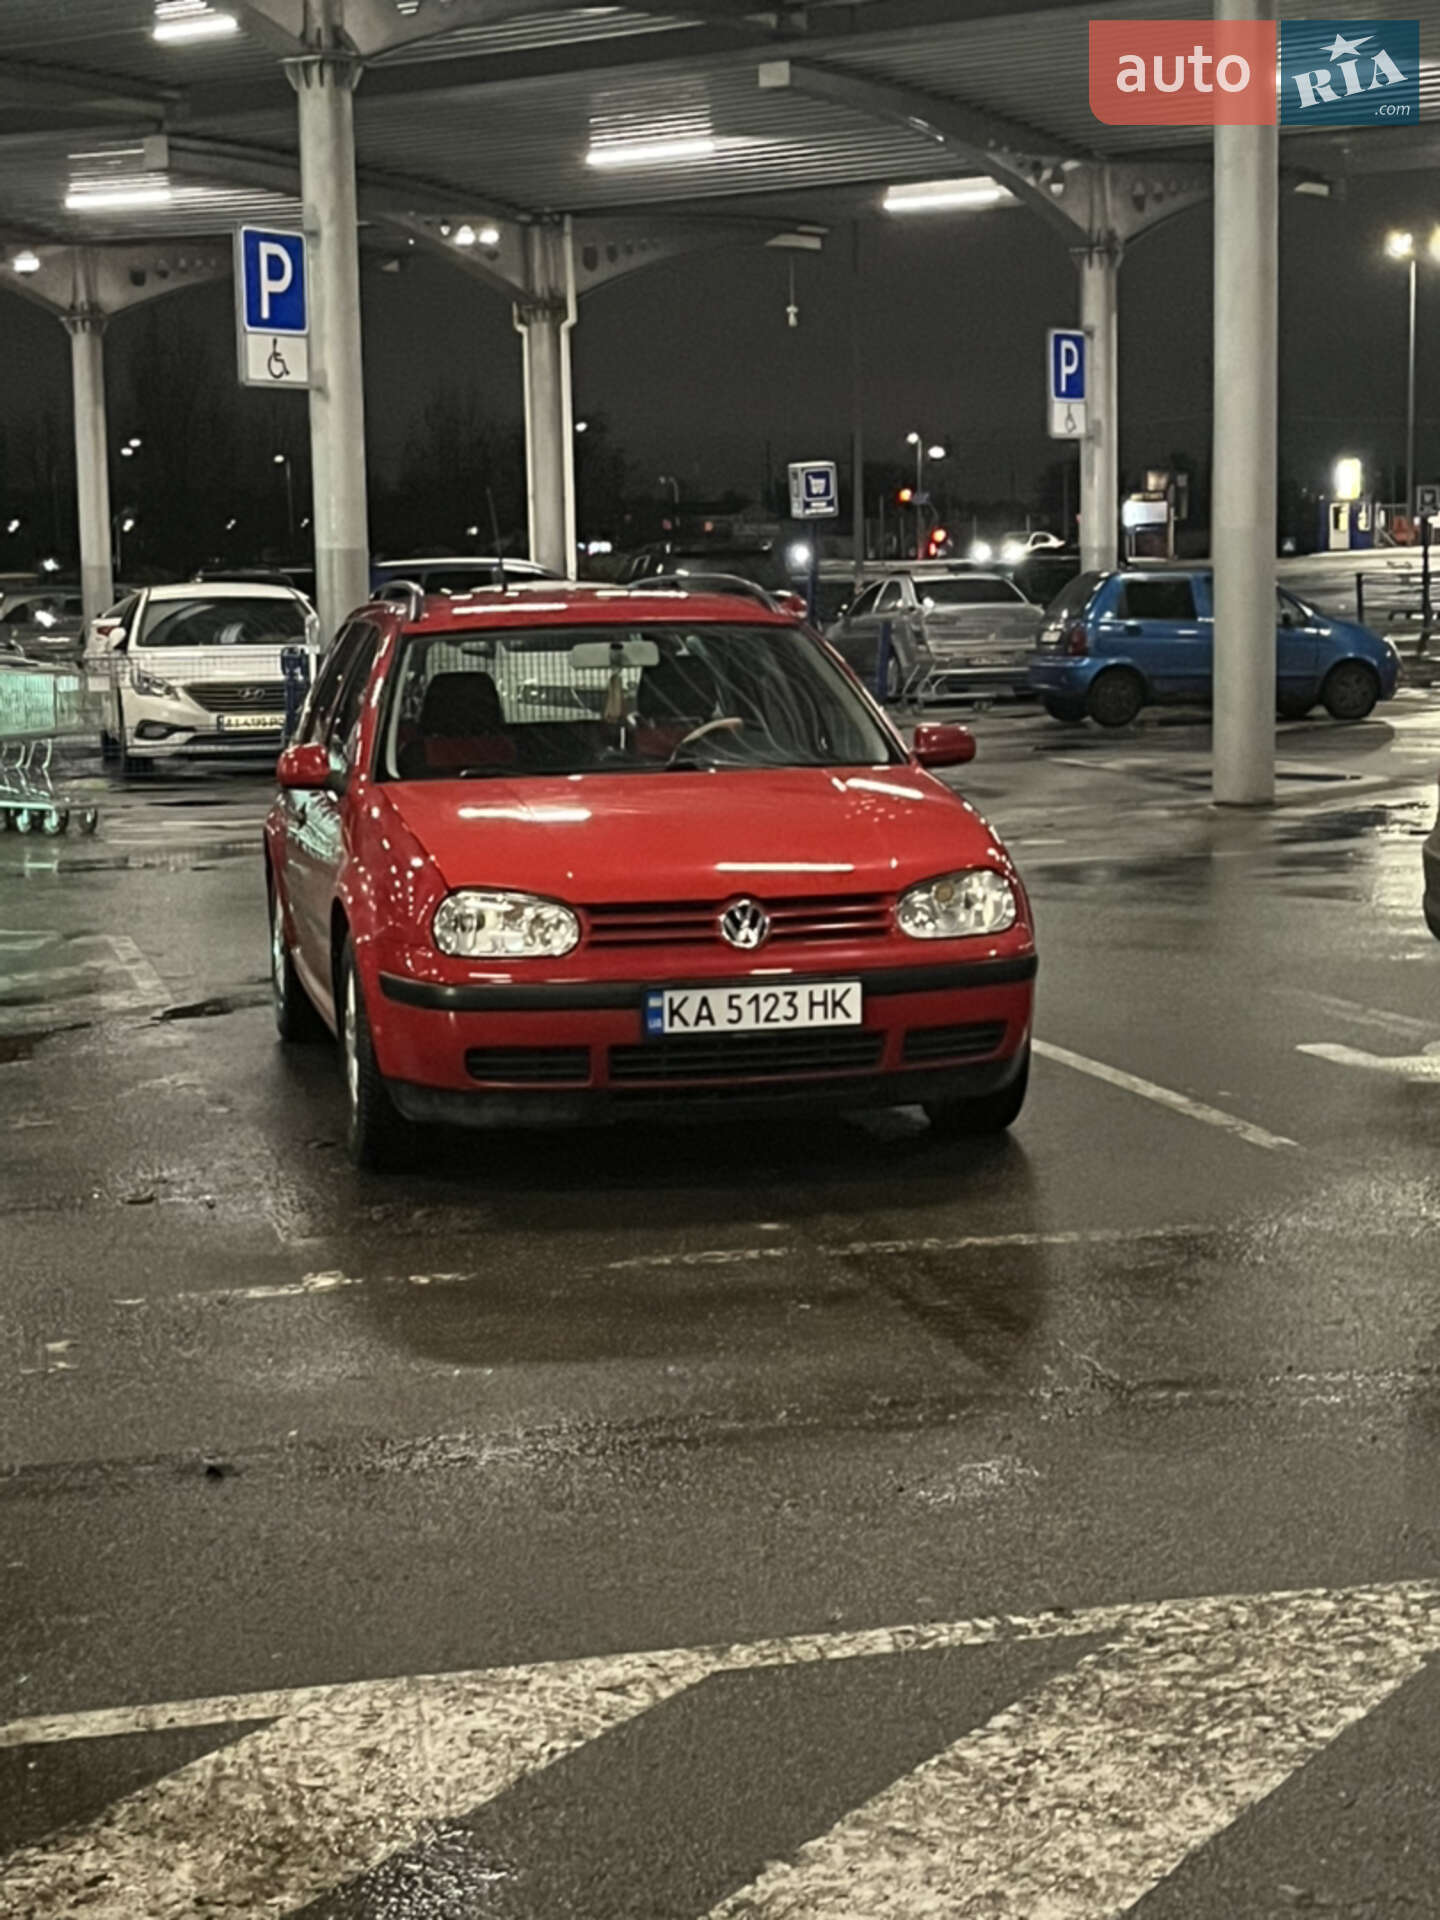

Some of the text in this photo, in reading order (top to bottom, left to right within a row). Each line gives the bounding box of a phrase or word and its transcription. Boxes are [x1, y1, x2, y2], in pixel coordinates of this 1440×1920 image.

[259, 241, 293, 319] P
[1061, 340, 1079, 392] P
[668, 987, 852, 1028] KA 5123 HK
